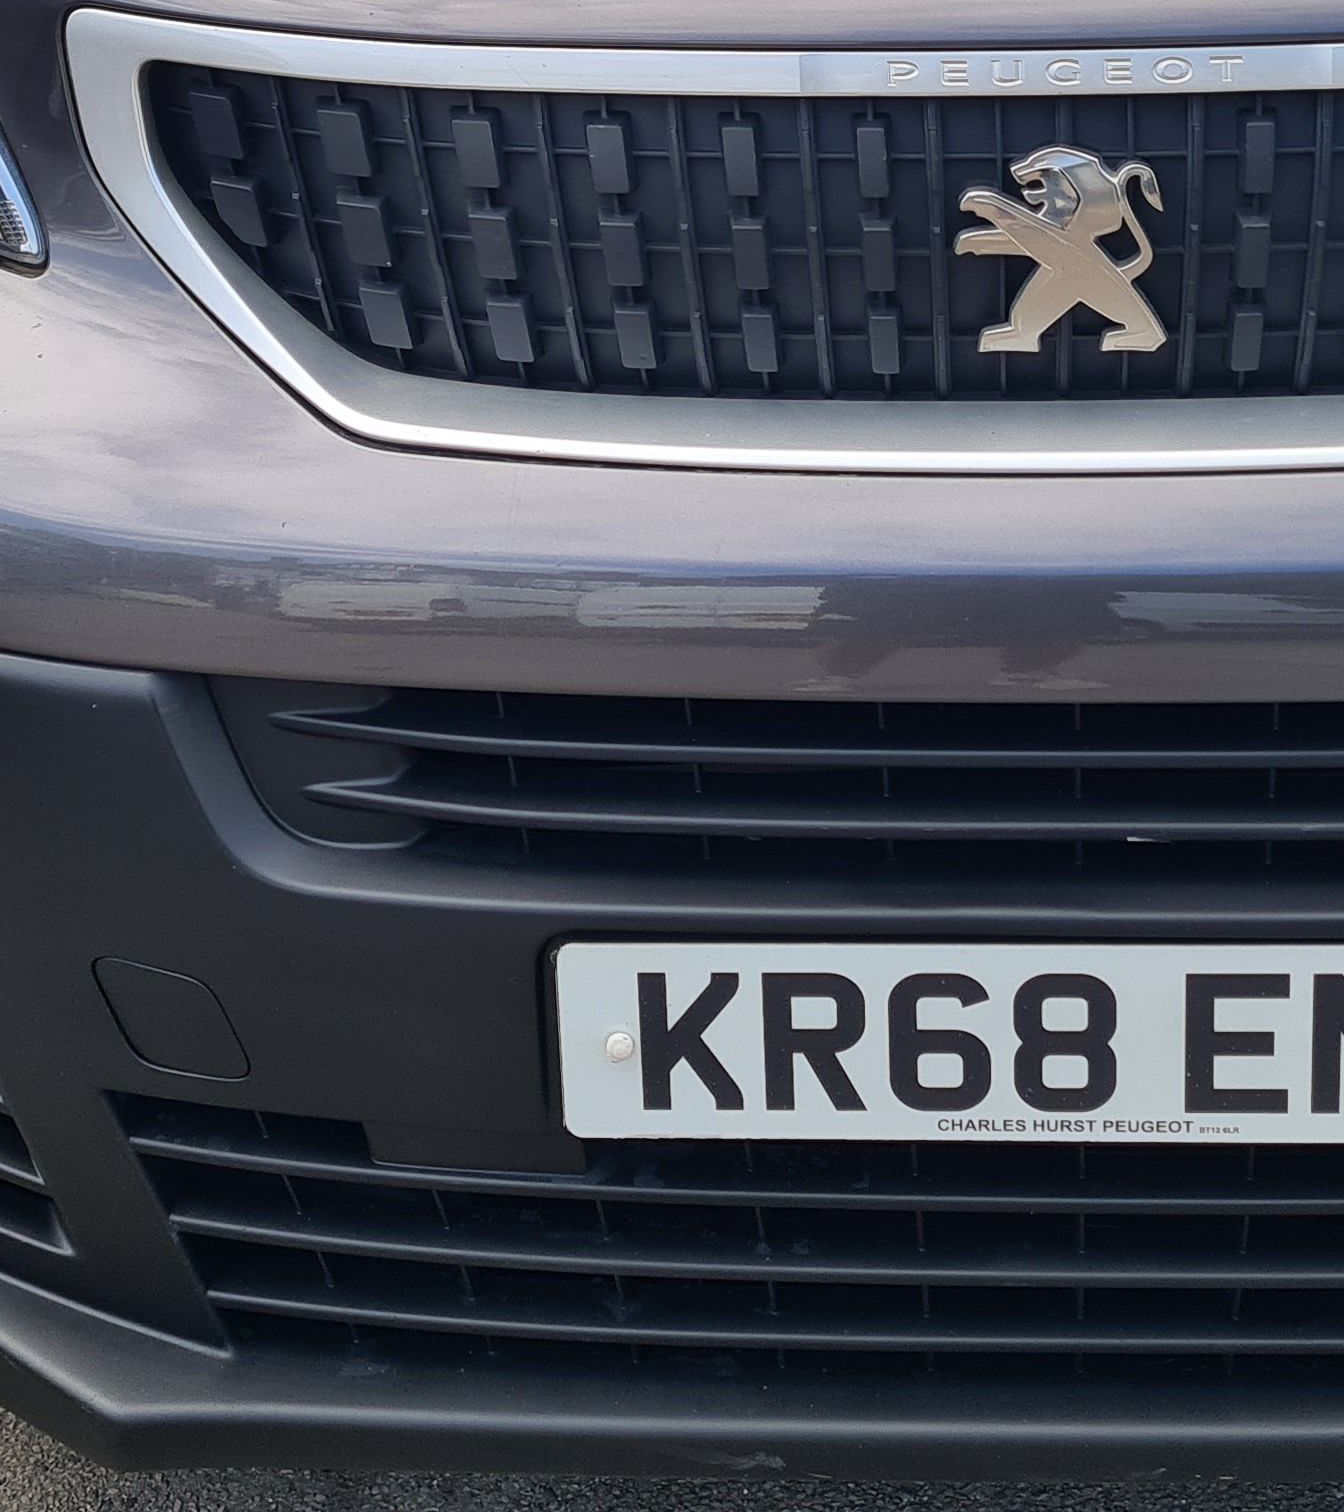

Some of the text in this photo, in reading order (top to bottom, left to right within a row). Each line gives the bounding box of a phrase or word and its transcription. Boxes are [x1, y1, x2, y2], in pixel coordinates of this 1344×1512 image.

[886, 55, 1245, 87] PEUGEOT
[635, 971, 1118, 1113] KR68
[937, 1118, 1027, 1132] CHARLES
[1032, 1119, 1097, 1133] HURST
[1103, 1120, 1195, 1134] PEUGEOT
